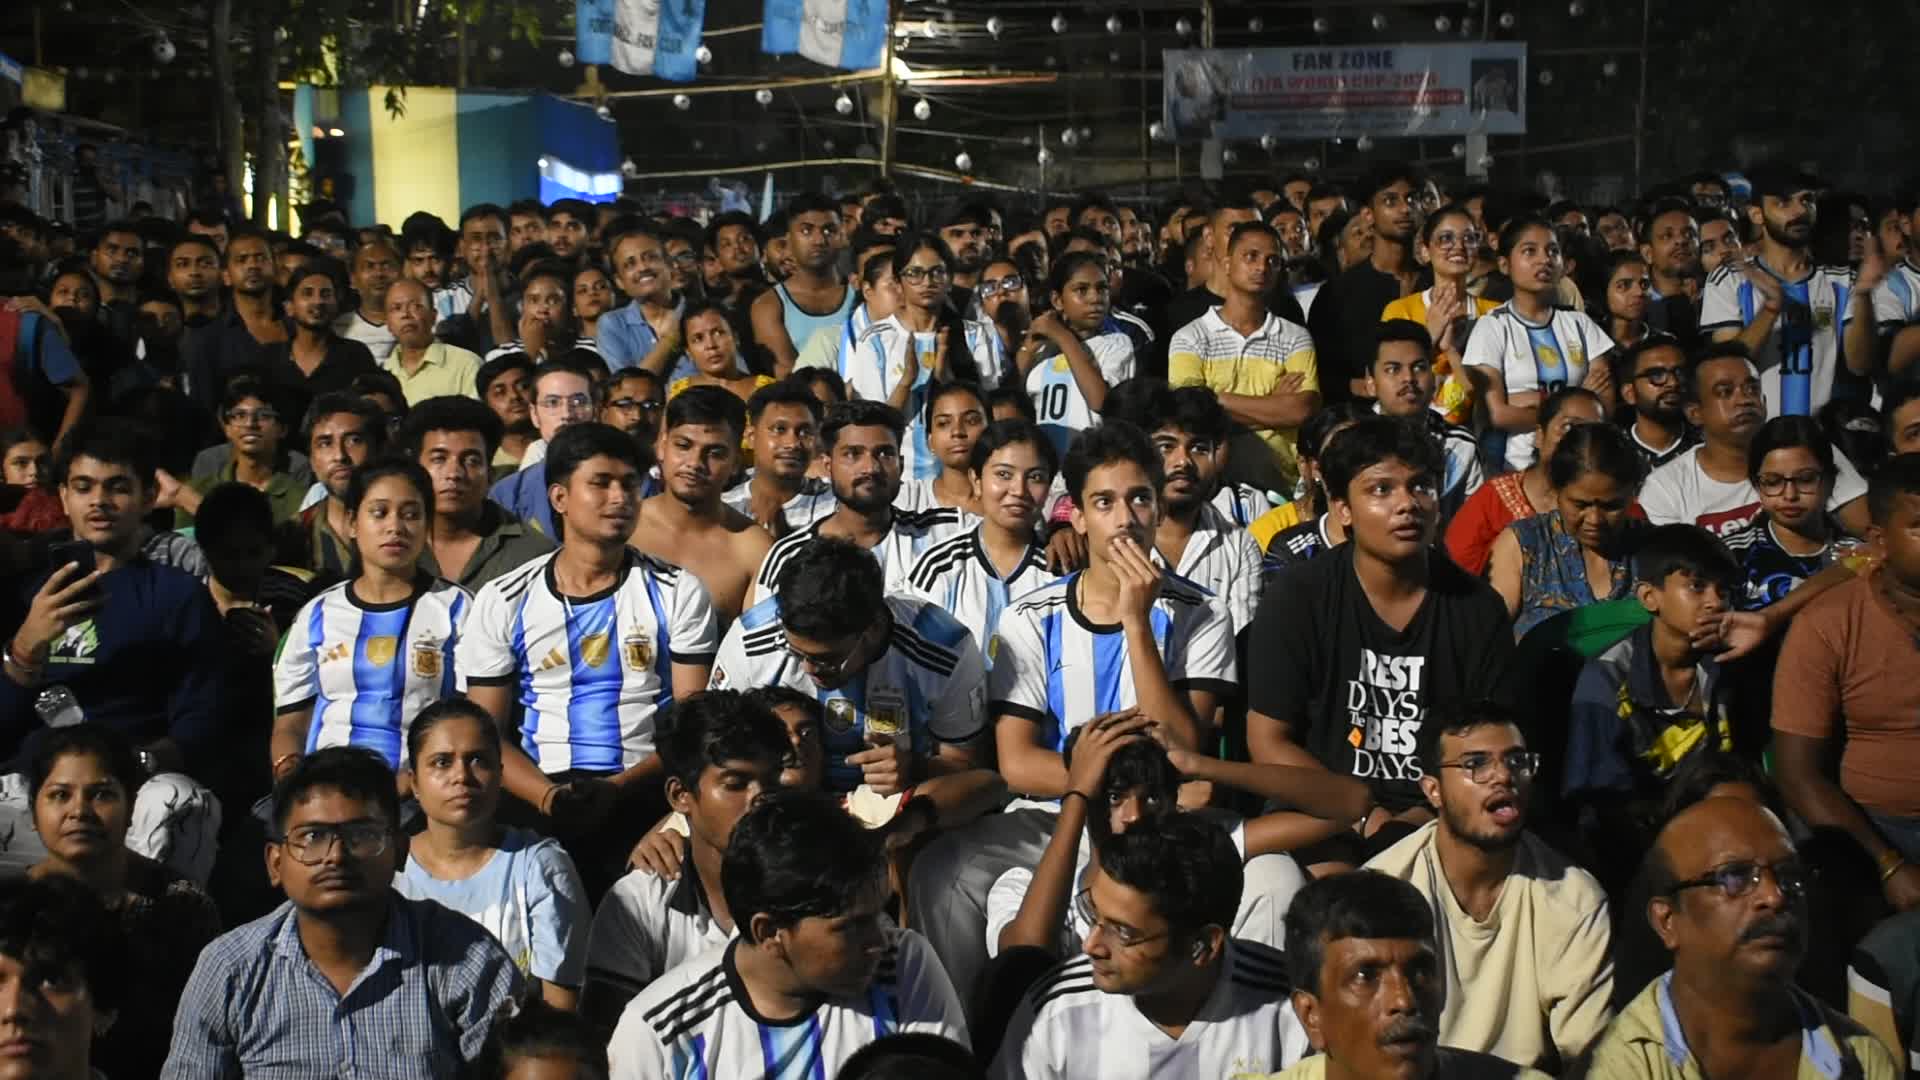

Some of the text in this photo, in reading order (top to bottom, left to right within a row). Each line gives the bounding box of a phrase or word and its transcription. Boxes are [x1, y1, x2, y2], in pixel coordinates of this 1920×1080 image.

[1291, 50, 1394, 71] FAN ZONE
[1041, 383, 1068, 421] 10
[1359, 648, 1425, 691] REST
[1364, 716, 1422, 755] BES
[1352, 748, 1424, 781] DAYS
